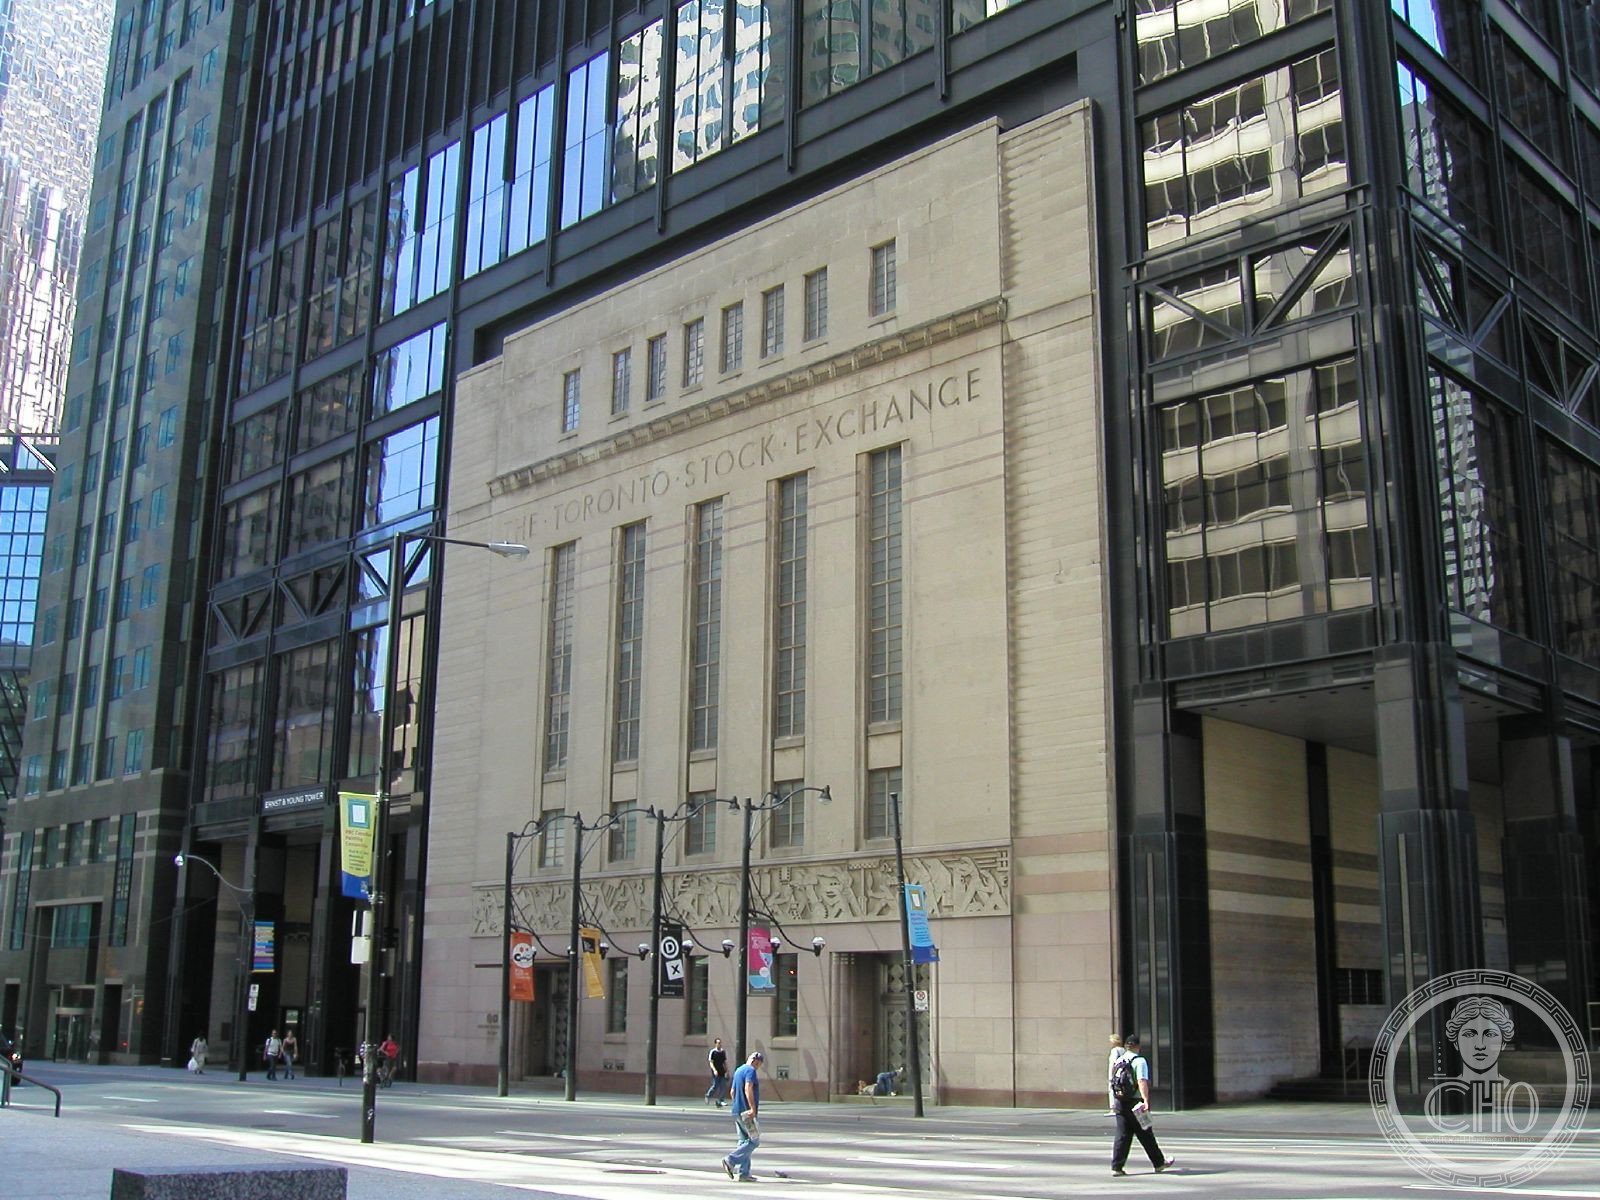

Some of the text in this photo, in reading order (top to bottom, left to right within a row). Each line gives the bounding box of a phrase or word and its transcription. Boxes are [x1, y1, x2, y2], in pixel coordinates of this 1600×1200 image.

[503, 367, 981, 541] THE TORONTO STOCK EXCHANGE
[671, 964, 681, 976] X
